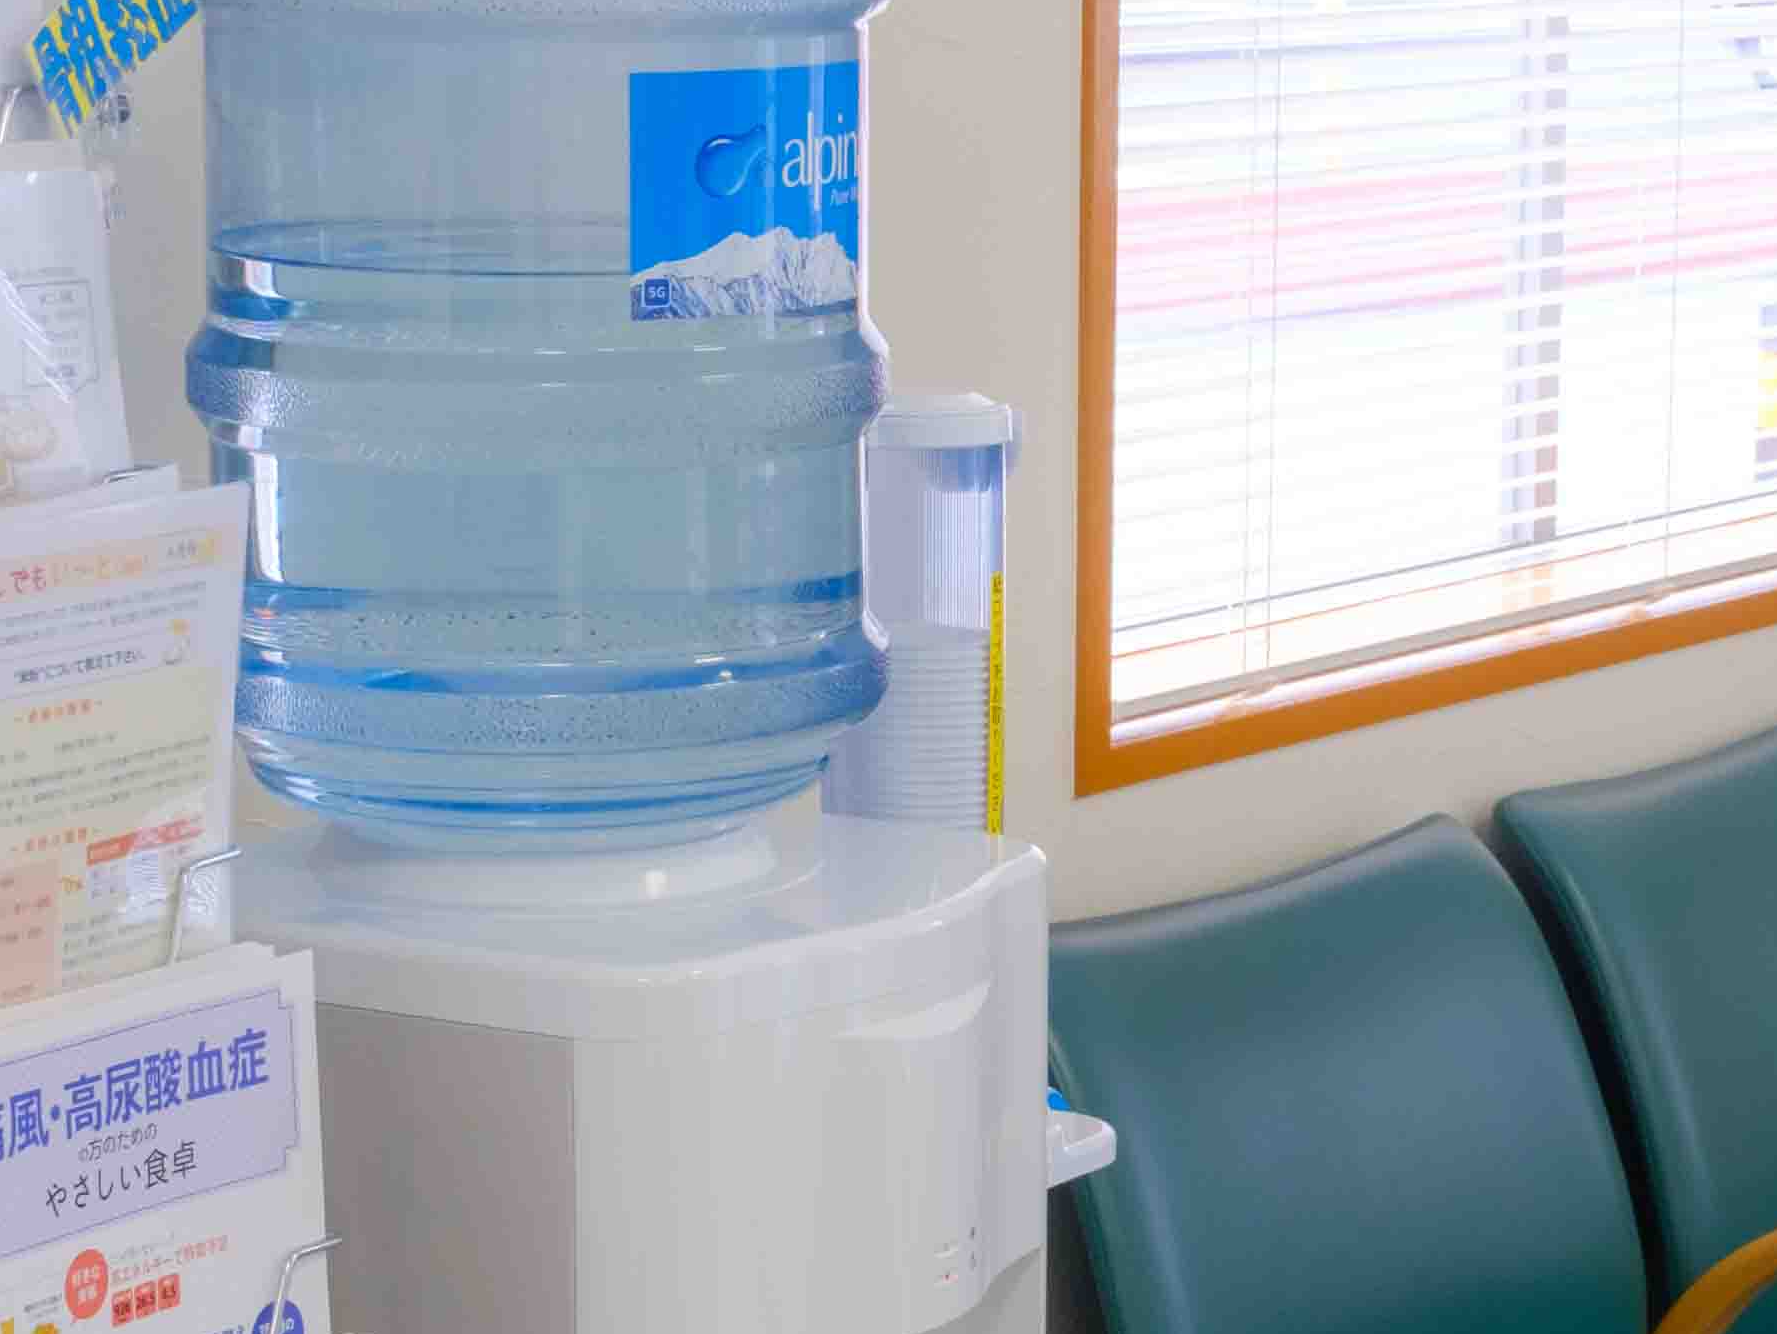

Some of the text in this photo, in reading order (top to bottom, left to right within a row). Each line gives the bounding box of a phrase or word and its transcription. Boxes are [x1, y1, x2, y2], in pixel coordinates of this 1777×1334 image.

[78, 1123, 157, 1163] の方のための
[46, 1141, 198, 1218] やさしい食卓
